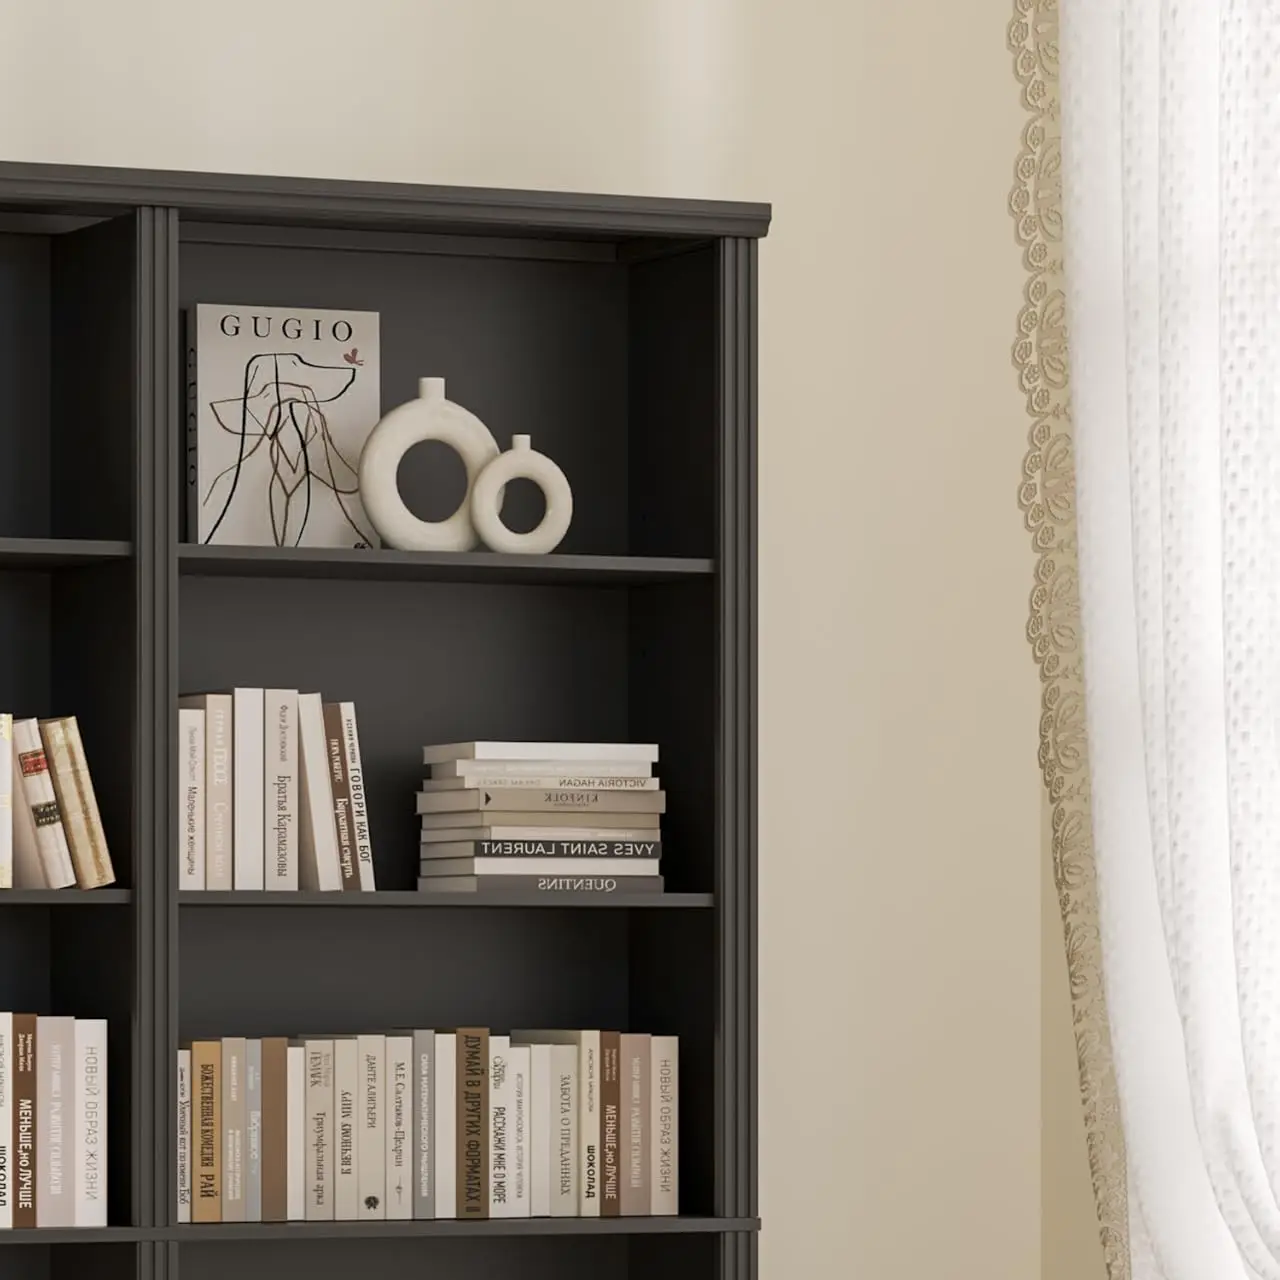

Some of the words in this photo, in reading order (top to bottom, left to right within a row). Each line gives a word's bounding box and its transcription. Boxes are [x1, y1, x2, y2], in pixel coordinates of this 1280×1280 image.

[220, 314, 355, 343] GUGIO
[187, 786, 198, 833] Маленькие
[273, 775, 291, 811] Братья
[350, 768, 365, 817] ГОВОРИ
[273, 814, 291, 877] Карамазовы
[355, 820, 368, 841] КАК
[186, 834, 197, 876] женщины
[359, 845, 372, 864] БОГ
[84, 1046, 100, 1097] НОВЫЙ
[365, 1054, 377, 1083] ДАНТЕ
[464, 1035, 485, 1076] ДУМАЙ
[200, 1064, 214, 1127] БОЖЕСТВЕННАЯ
[465, 1079, 480, 1087] В
[560, 1074, 571, 1114] ЗАБОТА
[660, 1059, 673, 1102] НОВЫЙ
[84, 1101, 98, 1145] ОБРАЗ
[341, 1090, 352, 1119] МИРУ
[366, 1084, 377, 1128] АЛИГЬЕРИ
[392, 1082, 406, 1167] Салтыков-Щедрин
[463, 1090, 481, 1135] ДРУГИХ
[560, 1118, 571, 1126] О
[341, 1122, 352, 1166] ВЕЧНОМУ
[493, 1107, 506, 1151] РАССКАЖИ
[660, 1106, 672, 1145] ОБРАЗ
[200, 1129, 214, 1167] КОМЕДИЯ
[312, 1112, 327, 1181] Триумфальная
[493, 1153, 506, 1171] МНЕ
[560, 1129, 571, 1195] ПРЕДАННЫХ
[18, 1168, 32, 1208] ЛУЧШЕ
[84, 1150, 98, 1201] ЖИЗНИ
[199, 1173, 218, 1199] РАЙ
[465, 1138, 481, 1202] ФОРМАТАХ
[585, 1145, 596, 1198] ШОКОЛАД
[605, 1165, 617, 1200] ЛУЧШЕ
[660, 1149, 672, 1192] ЖИЗНИ
[178, 1188, 189, 1204] Боб
[312, 1183, 325, 1205] арка
[493, 1181, 506, 1204] МОРЕ
